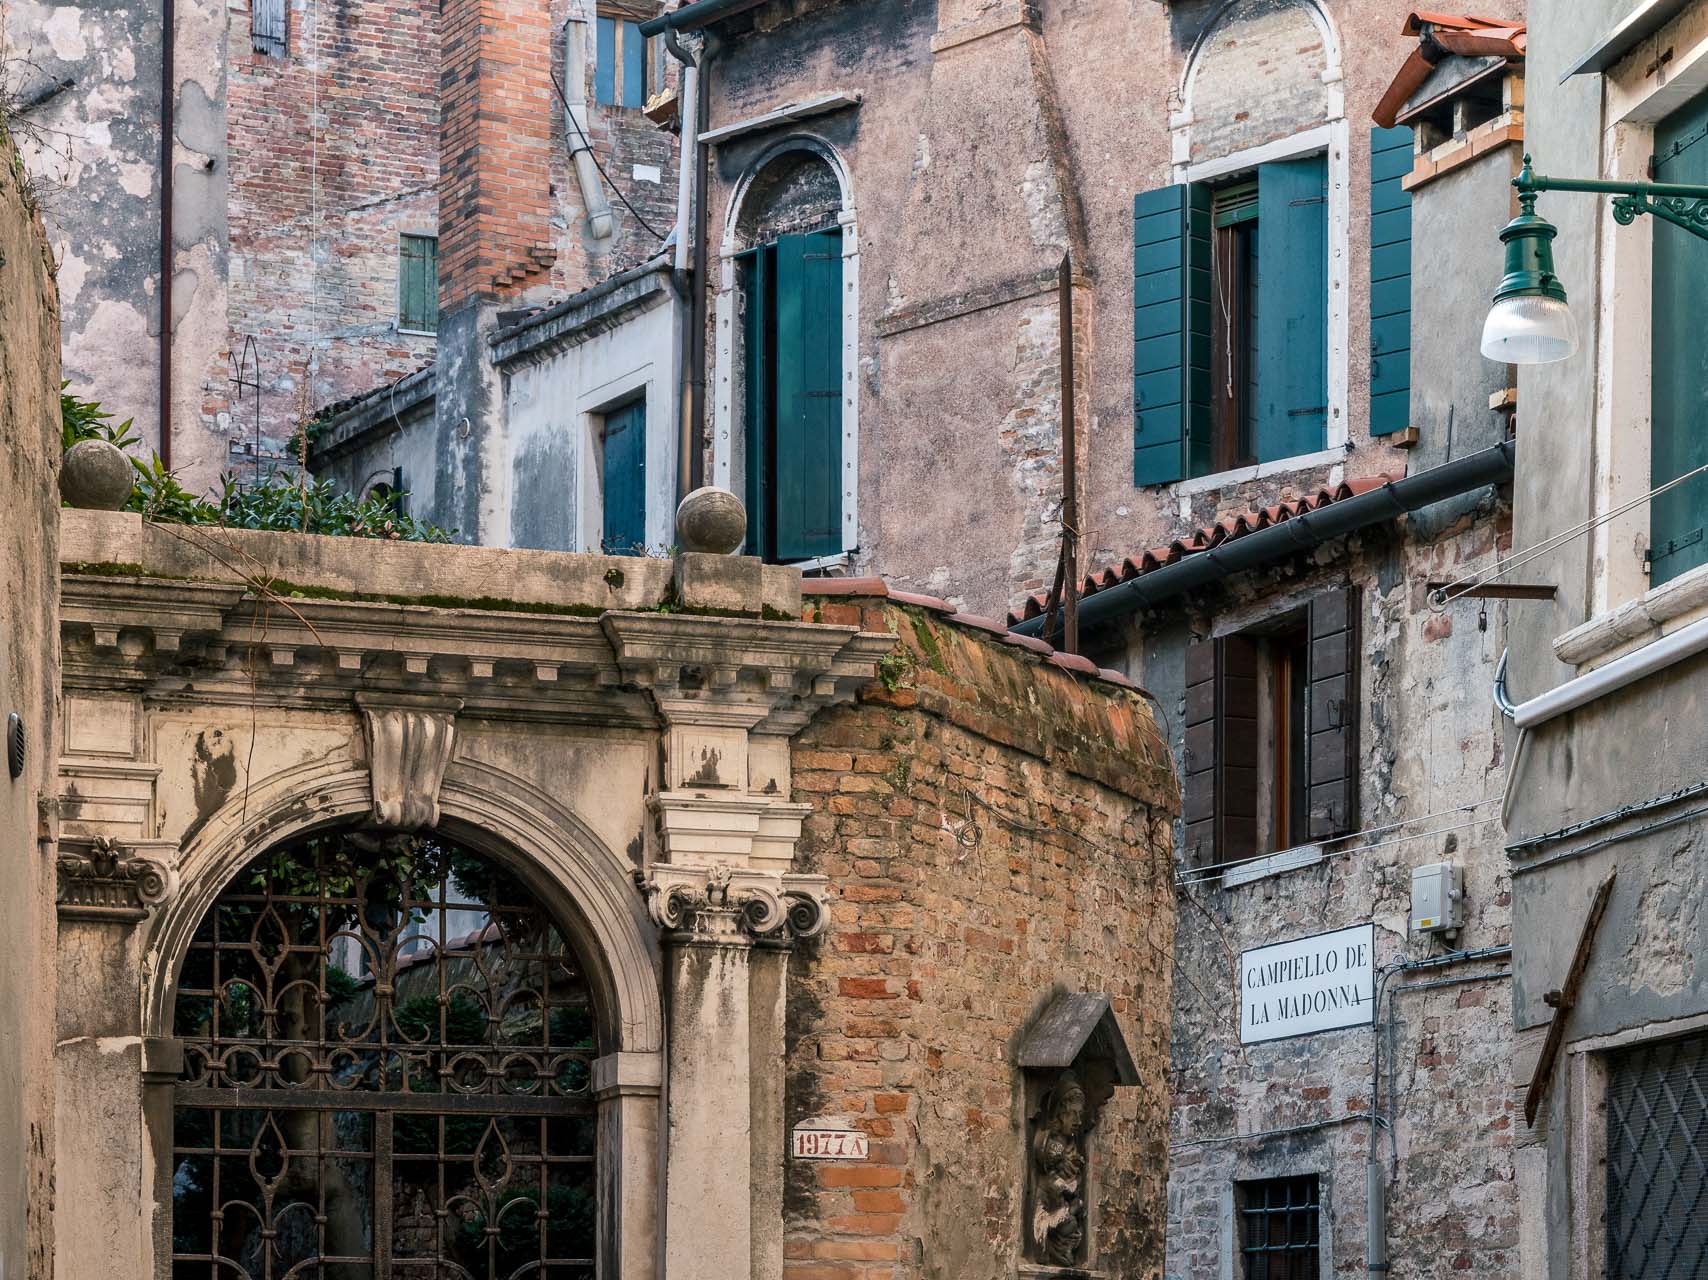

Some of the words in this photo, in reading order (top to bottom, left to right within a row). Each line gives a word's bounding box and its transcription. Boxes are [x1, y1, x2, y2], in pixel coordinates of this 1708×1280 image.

[1247, 950, 1338, 989] CAMPIELLO
[1345, 943, 1367, 970] DE
[1250, 1001, 1270, 1026] LA
[1277, 983, 1361, 1021] MADONNA
